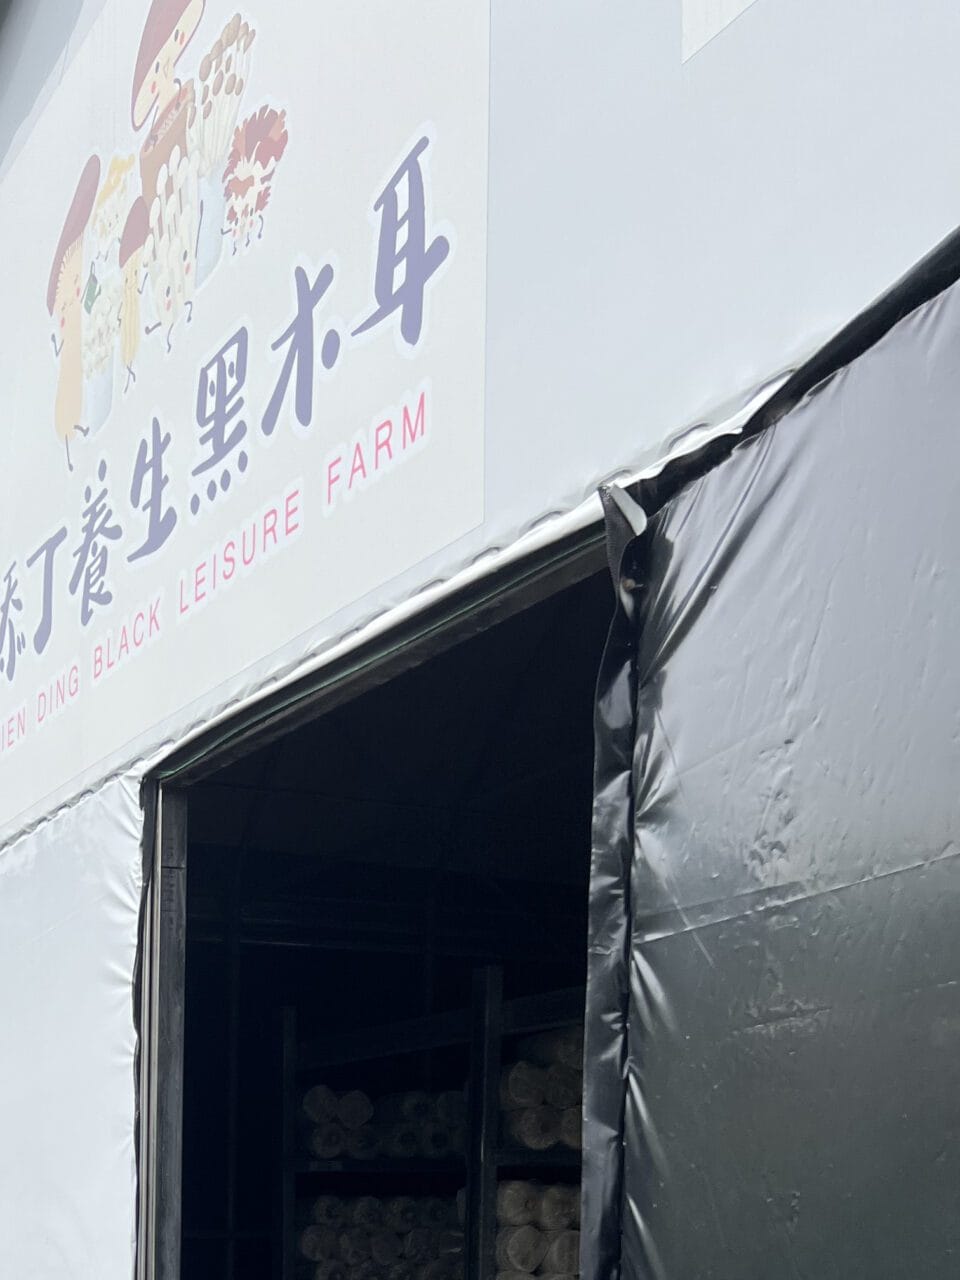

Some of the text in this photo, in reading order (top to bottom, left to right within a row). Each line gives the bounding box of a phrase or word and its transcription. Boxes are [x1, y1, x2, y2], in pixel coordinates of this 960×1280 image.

[37, 665, 79, 723] DING
[93, 597, 161, 679] BLACK
[179, 489, 300, 614] LEISURE
[327, 391, 426, 505] FARM
